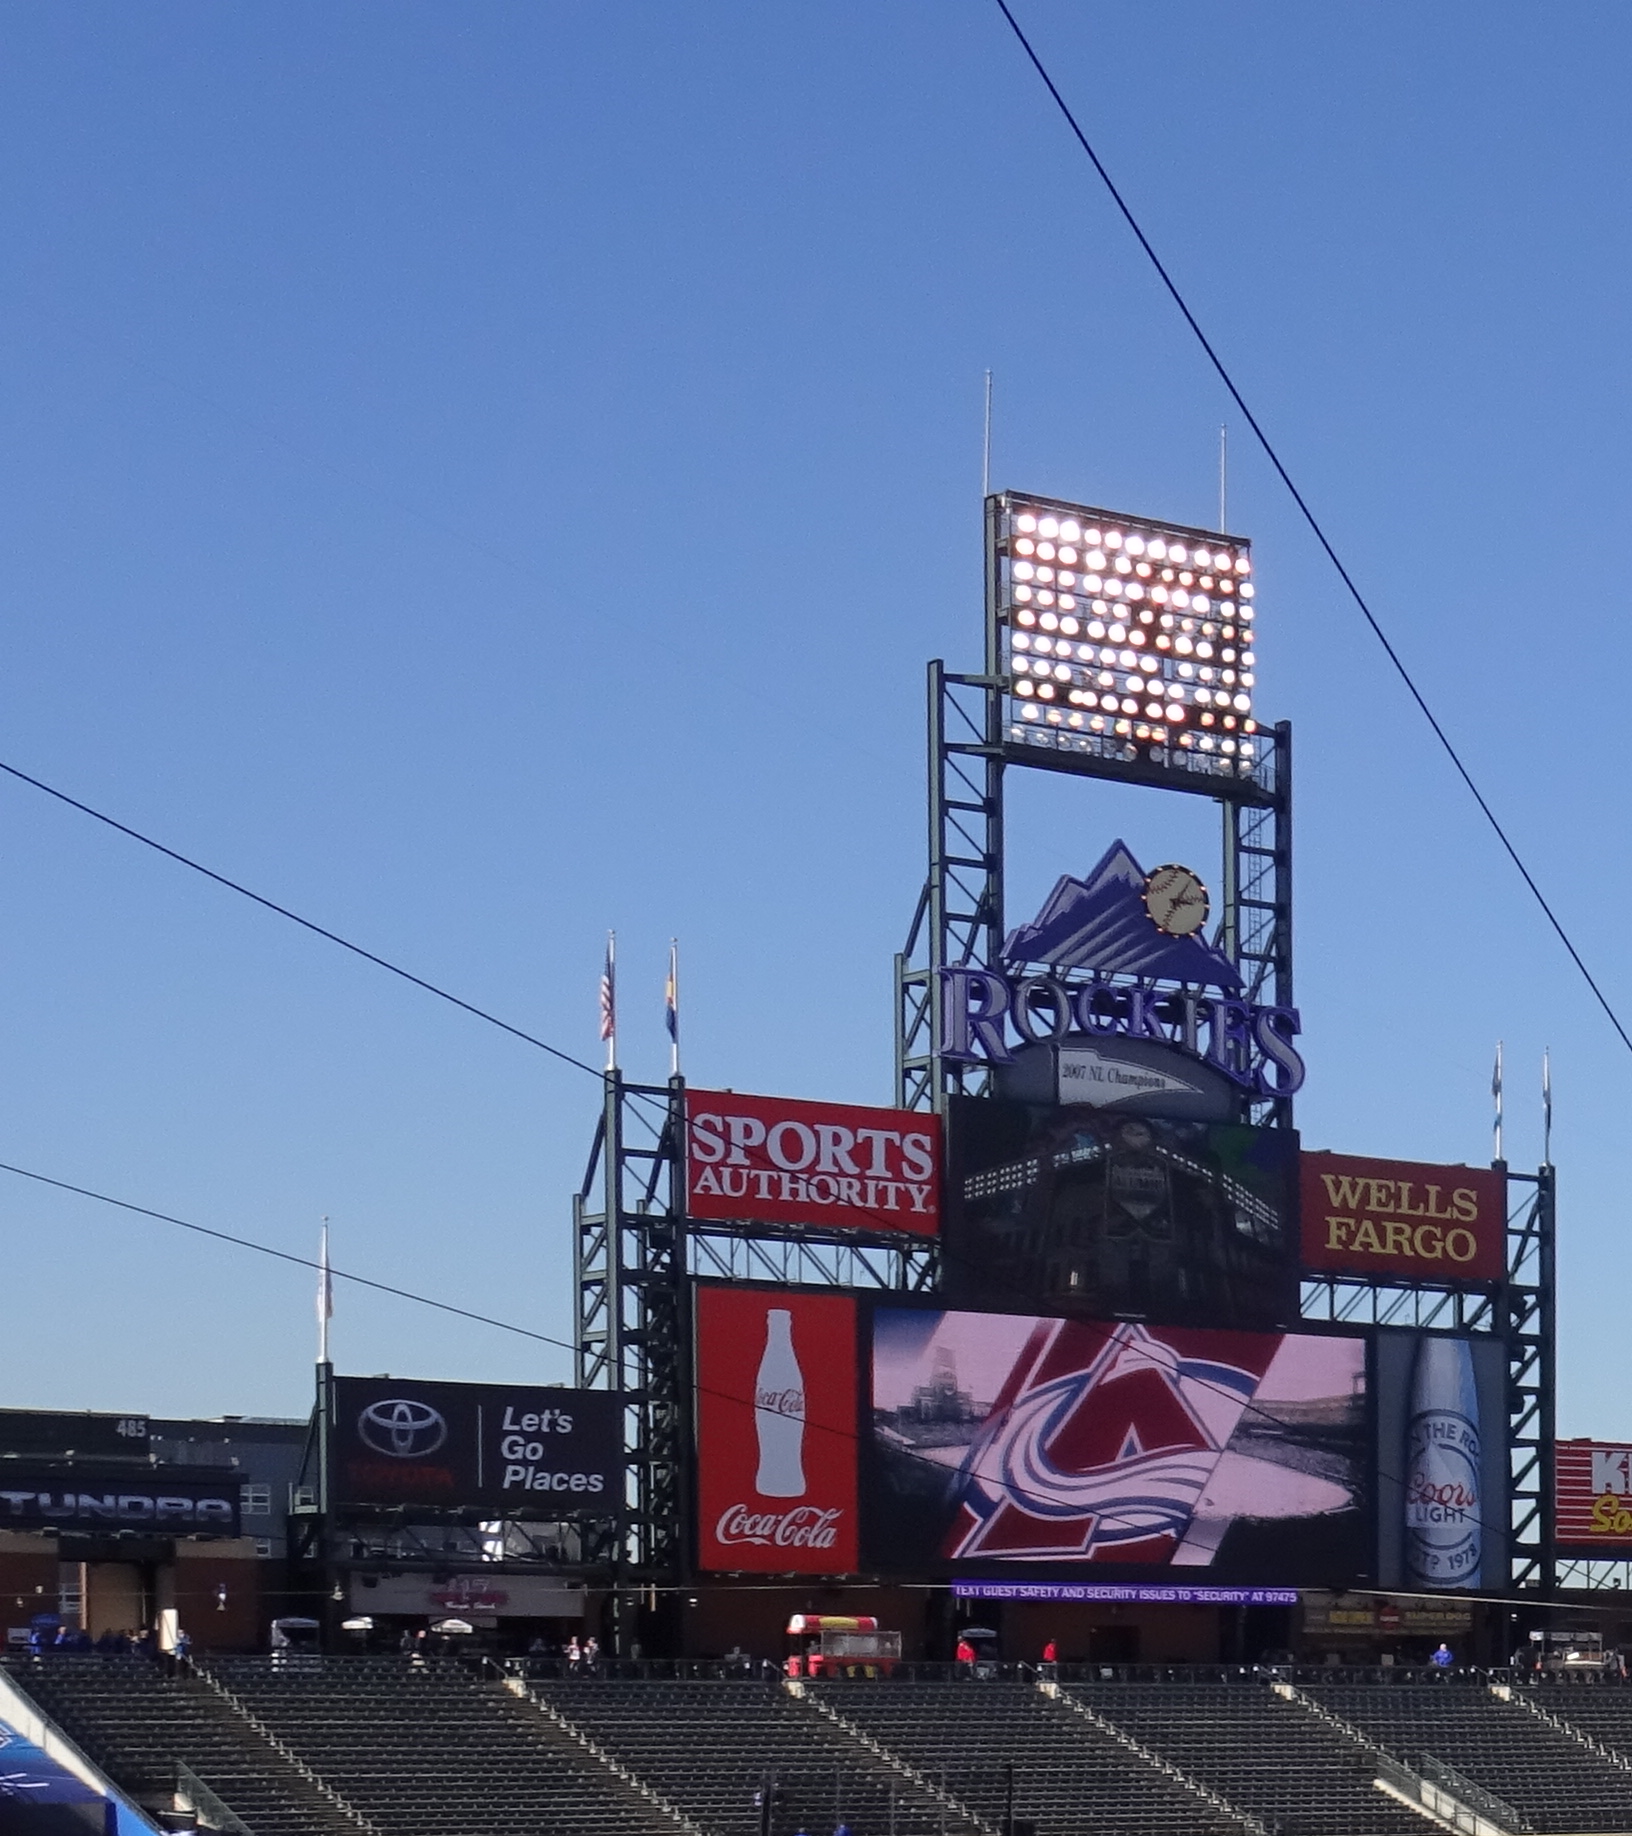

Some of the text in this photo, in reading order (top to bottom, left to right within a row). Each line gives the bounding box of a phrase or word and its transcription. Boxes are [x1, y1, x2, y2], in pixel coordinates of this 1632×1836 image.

[939, 964, 1306, 1098] ROCKIES
[1108, 1067, 1166, 1090] Champions
[691, 1113, 933, 1181] SPORTS
[693, 1165, 932, 1213] AUTHORITY
[1321, 1173, 1478, 1222] WELLS
[1324, 1215, 1478, 1263] FARGO
[116, 1419, 146, 1438] 485
[502, 1405, 573, 1433] Let's
[1424, 1422, 1457, 1441] THE
[501, 1435, 544, 1461] Go
[502, 1464, 605, 1492] Places
[1409, 1472, 1476, 1506] Coors
[0, 1490, 233, 1522] TUNDRA
[1416, 1506, 1467, 1524] LIGHT
[716, 1503, 844, 1549] Coca-Cola
[955, 1586, 980, 1597] TEXT
[983, 1586, 1017, 1598] GUEST
[1019, 1586, 1060, 1598] SAFETY
[1061, 1587, 1085, 1598] AND
[1087, 1588, 1137, 1600] SECURITY
[1139, 1589, 1176, 1600] ISSUES
[1178, 1590, 1191, 1600] TO
[1251, 1591, 1264, 1602] AT
[1265, 1592, 1297, 1602] 97475
